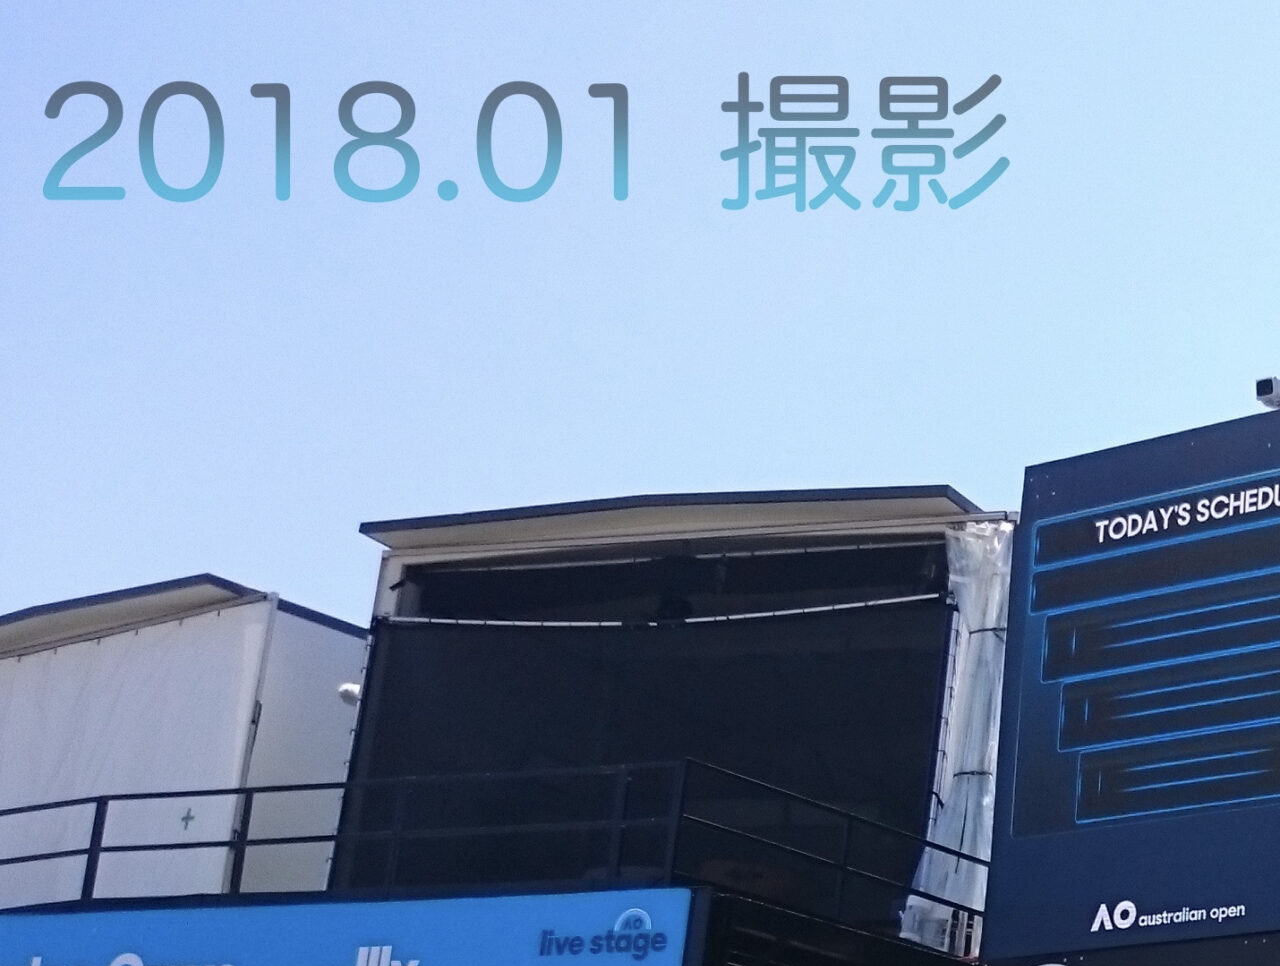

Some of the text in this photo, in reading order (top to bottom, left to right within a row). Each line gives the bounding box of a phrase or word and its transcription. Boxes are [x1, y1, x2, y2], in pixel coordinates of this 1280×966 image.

[1096, 501, 1191, 543] TODAY'S
[1090, 900, 1246, 932] AO australian open
[539, 929, 668, 962] live stage
